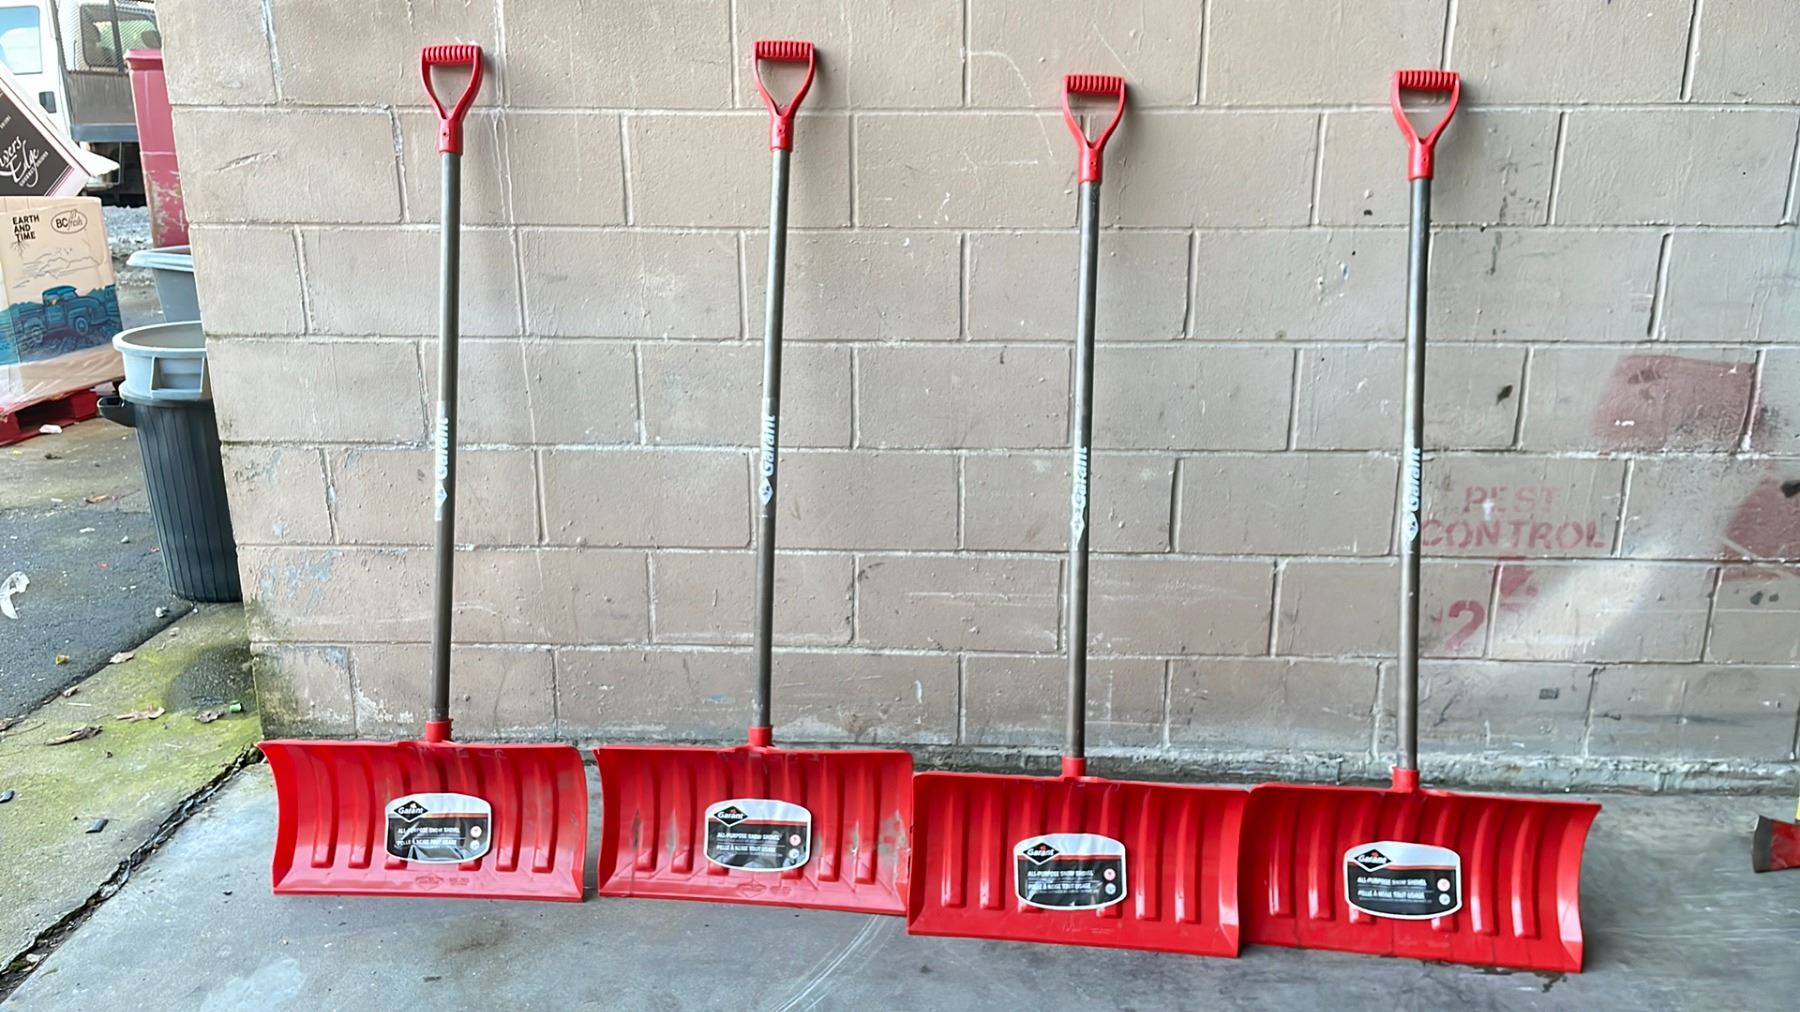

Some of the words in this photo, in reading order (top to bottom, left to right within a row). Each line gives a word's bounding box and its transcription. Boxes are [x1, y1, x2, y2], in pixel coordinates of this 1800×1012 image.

[0, 136, 22, 167] ivers
[12, 214, 40, 225] EARTH
[14, 224, 31, 233] AND
[15, 231, 36, 242] TIME
[435, 417, 449, 480] Garant
[760, 415, 775, 477] Garant
[1072, 446, 1087, 507] Garant
[1402, 448, 1420, 512] Garant
[1464, 485, 1560, 513] PEST
[1421, 519, 1605, 549] CONTROL
[1446, 600, 1486, 651] 2
[398, 806, 424, 815] Garant
[717, 811, 745, 820] Garant
[1026, 848, 1055, 857] Garant
